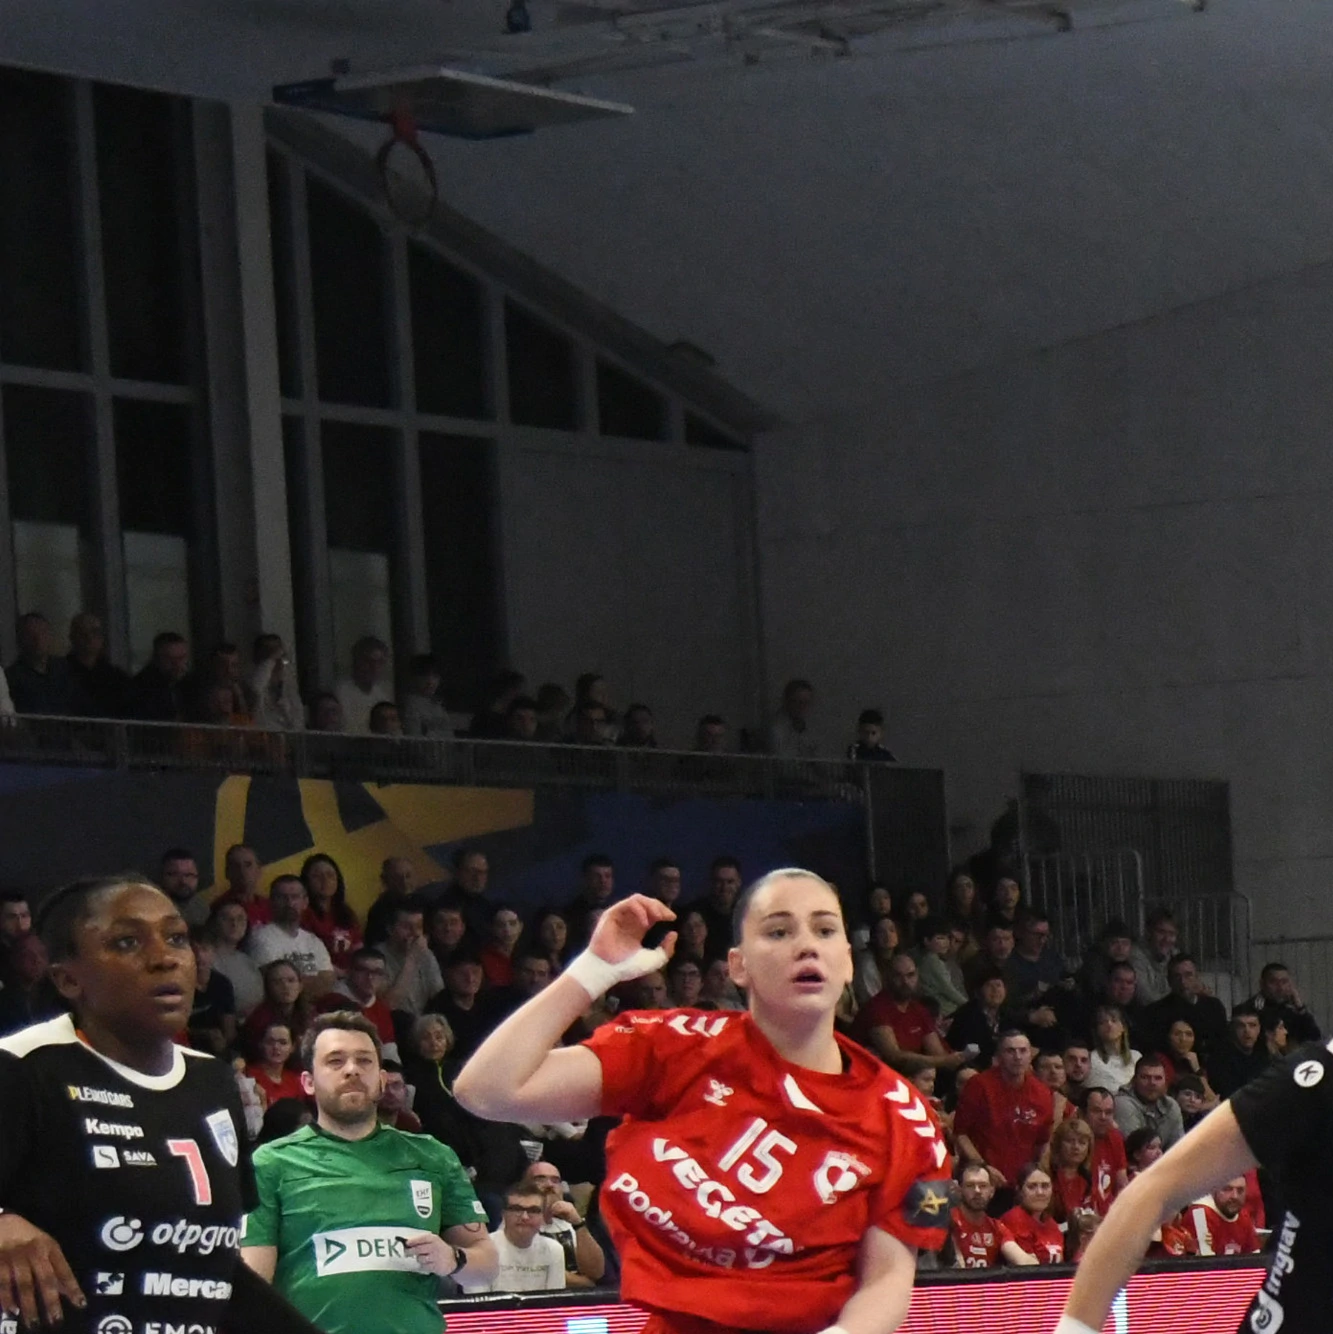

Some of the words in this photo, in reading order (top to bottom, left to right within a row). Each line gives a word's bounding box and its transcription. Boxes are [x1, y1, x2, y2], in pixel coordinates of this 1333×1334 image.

[85, 1118, 145, 1140] Kempa
[122, 1150, 156, 1163] SAVA
[718, 1117, 798, 1194] 15
[166, 1138, 212, 1205] 7
[151, 1218, 240, 1255] otpgro
[356, 1238, 402, 1258] DEK
[143, 1272, 233, 1300] Merca
